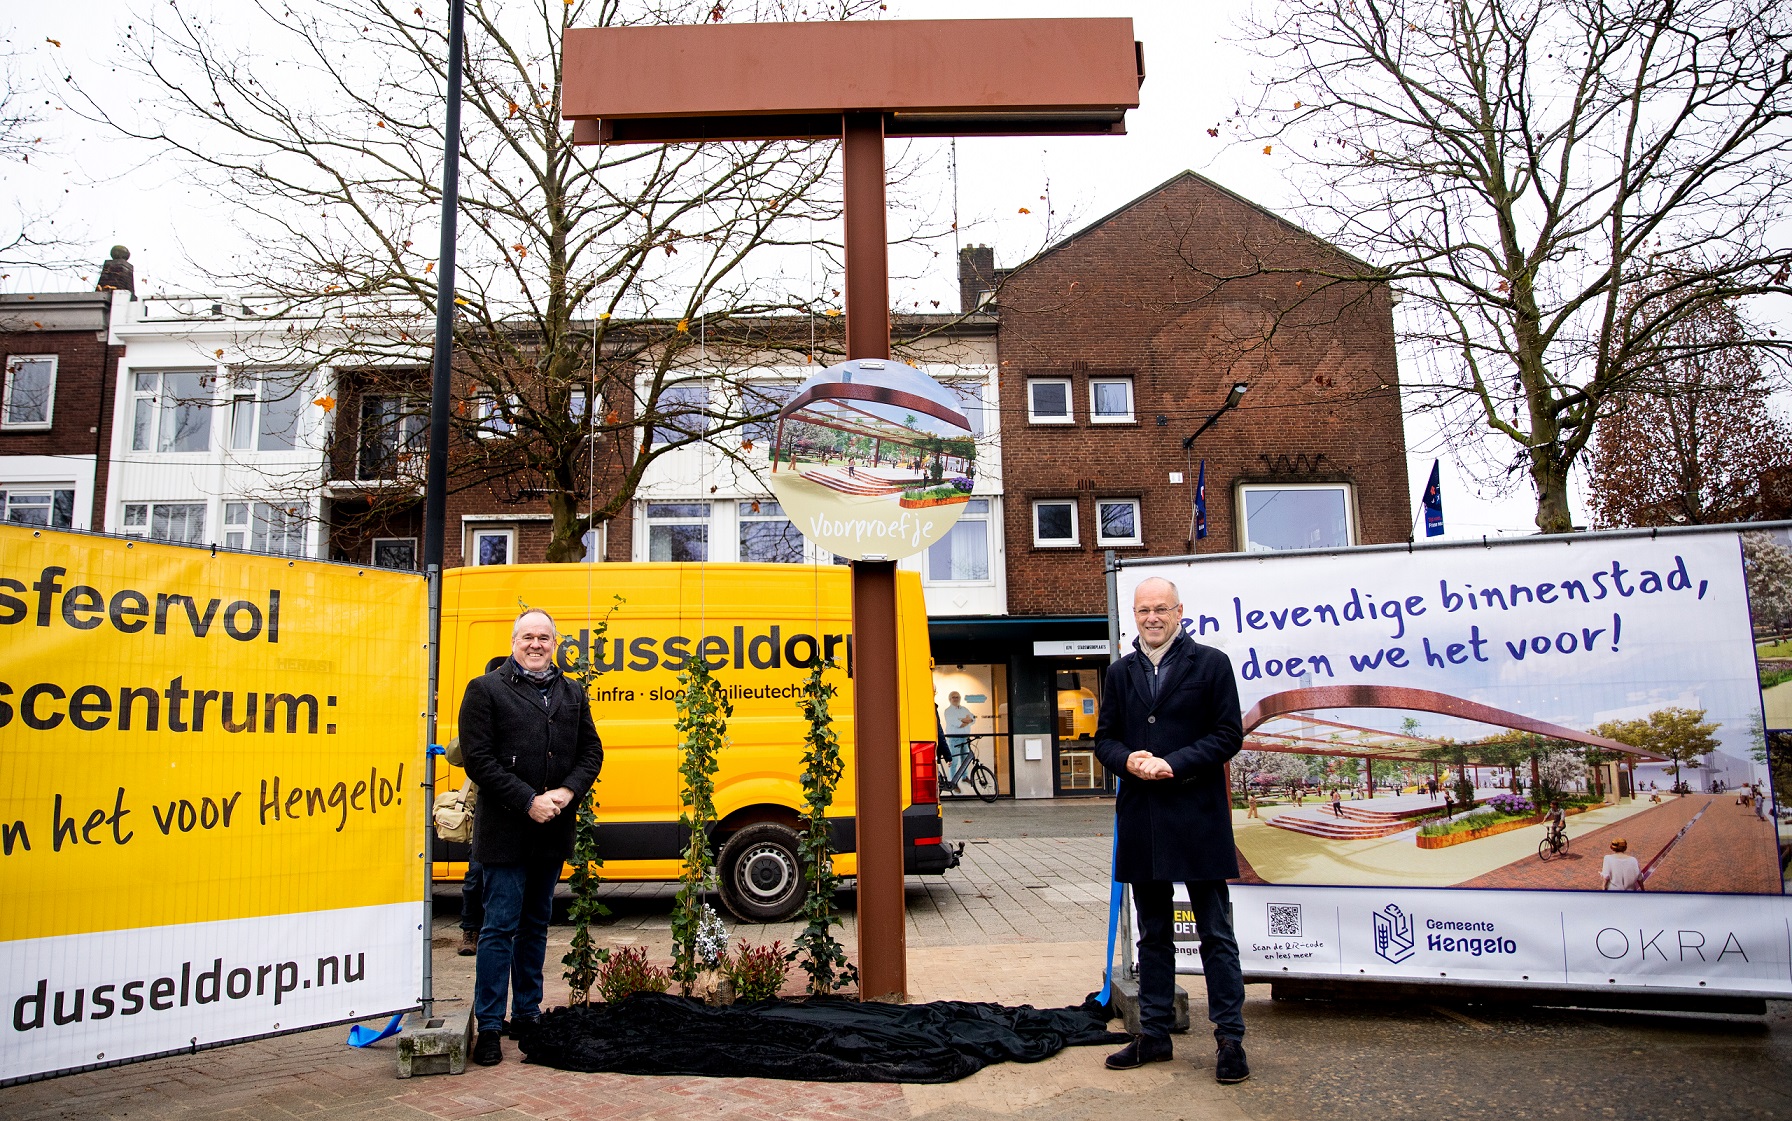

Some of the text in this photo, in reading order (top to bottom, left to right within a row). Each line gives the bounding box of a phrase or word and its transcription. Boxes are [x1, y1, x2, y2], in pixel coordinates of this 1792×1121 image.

[810, 511, 934, 548] Voorproefje
[0, 565, 281, 644] sfeervol
[1180, 555, 1709, 639] en levendige binnenstad,
[556, 624, 853, 679] dusseldor
[1241, 613, 1623, 681] doen we het voor!
[597, 686, 635, 701] infra
[650, 685, 687, 701] sloo
[53, 786, 134, 853] het
[152, 790, 242, 836] voor
[259, 762, 404, 833] Hengelo!
[1426, 918, 1495, 932] Gemeente
[1252, 940, 1324, 952] Scan de QR-code
[1276, 952, 1291, 960] lees
[1292, 951, 1314, 959] meer
[1427, 933, 1517, 957] Hengelo
[1596, 927, 1749, 963] OKRA
[13, 951, 366, 1032] dusseldorp.nu
